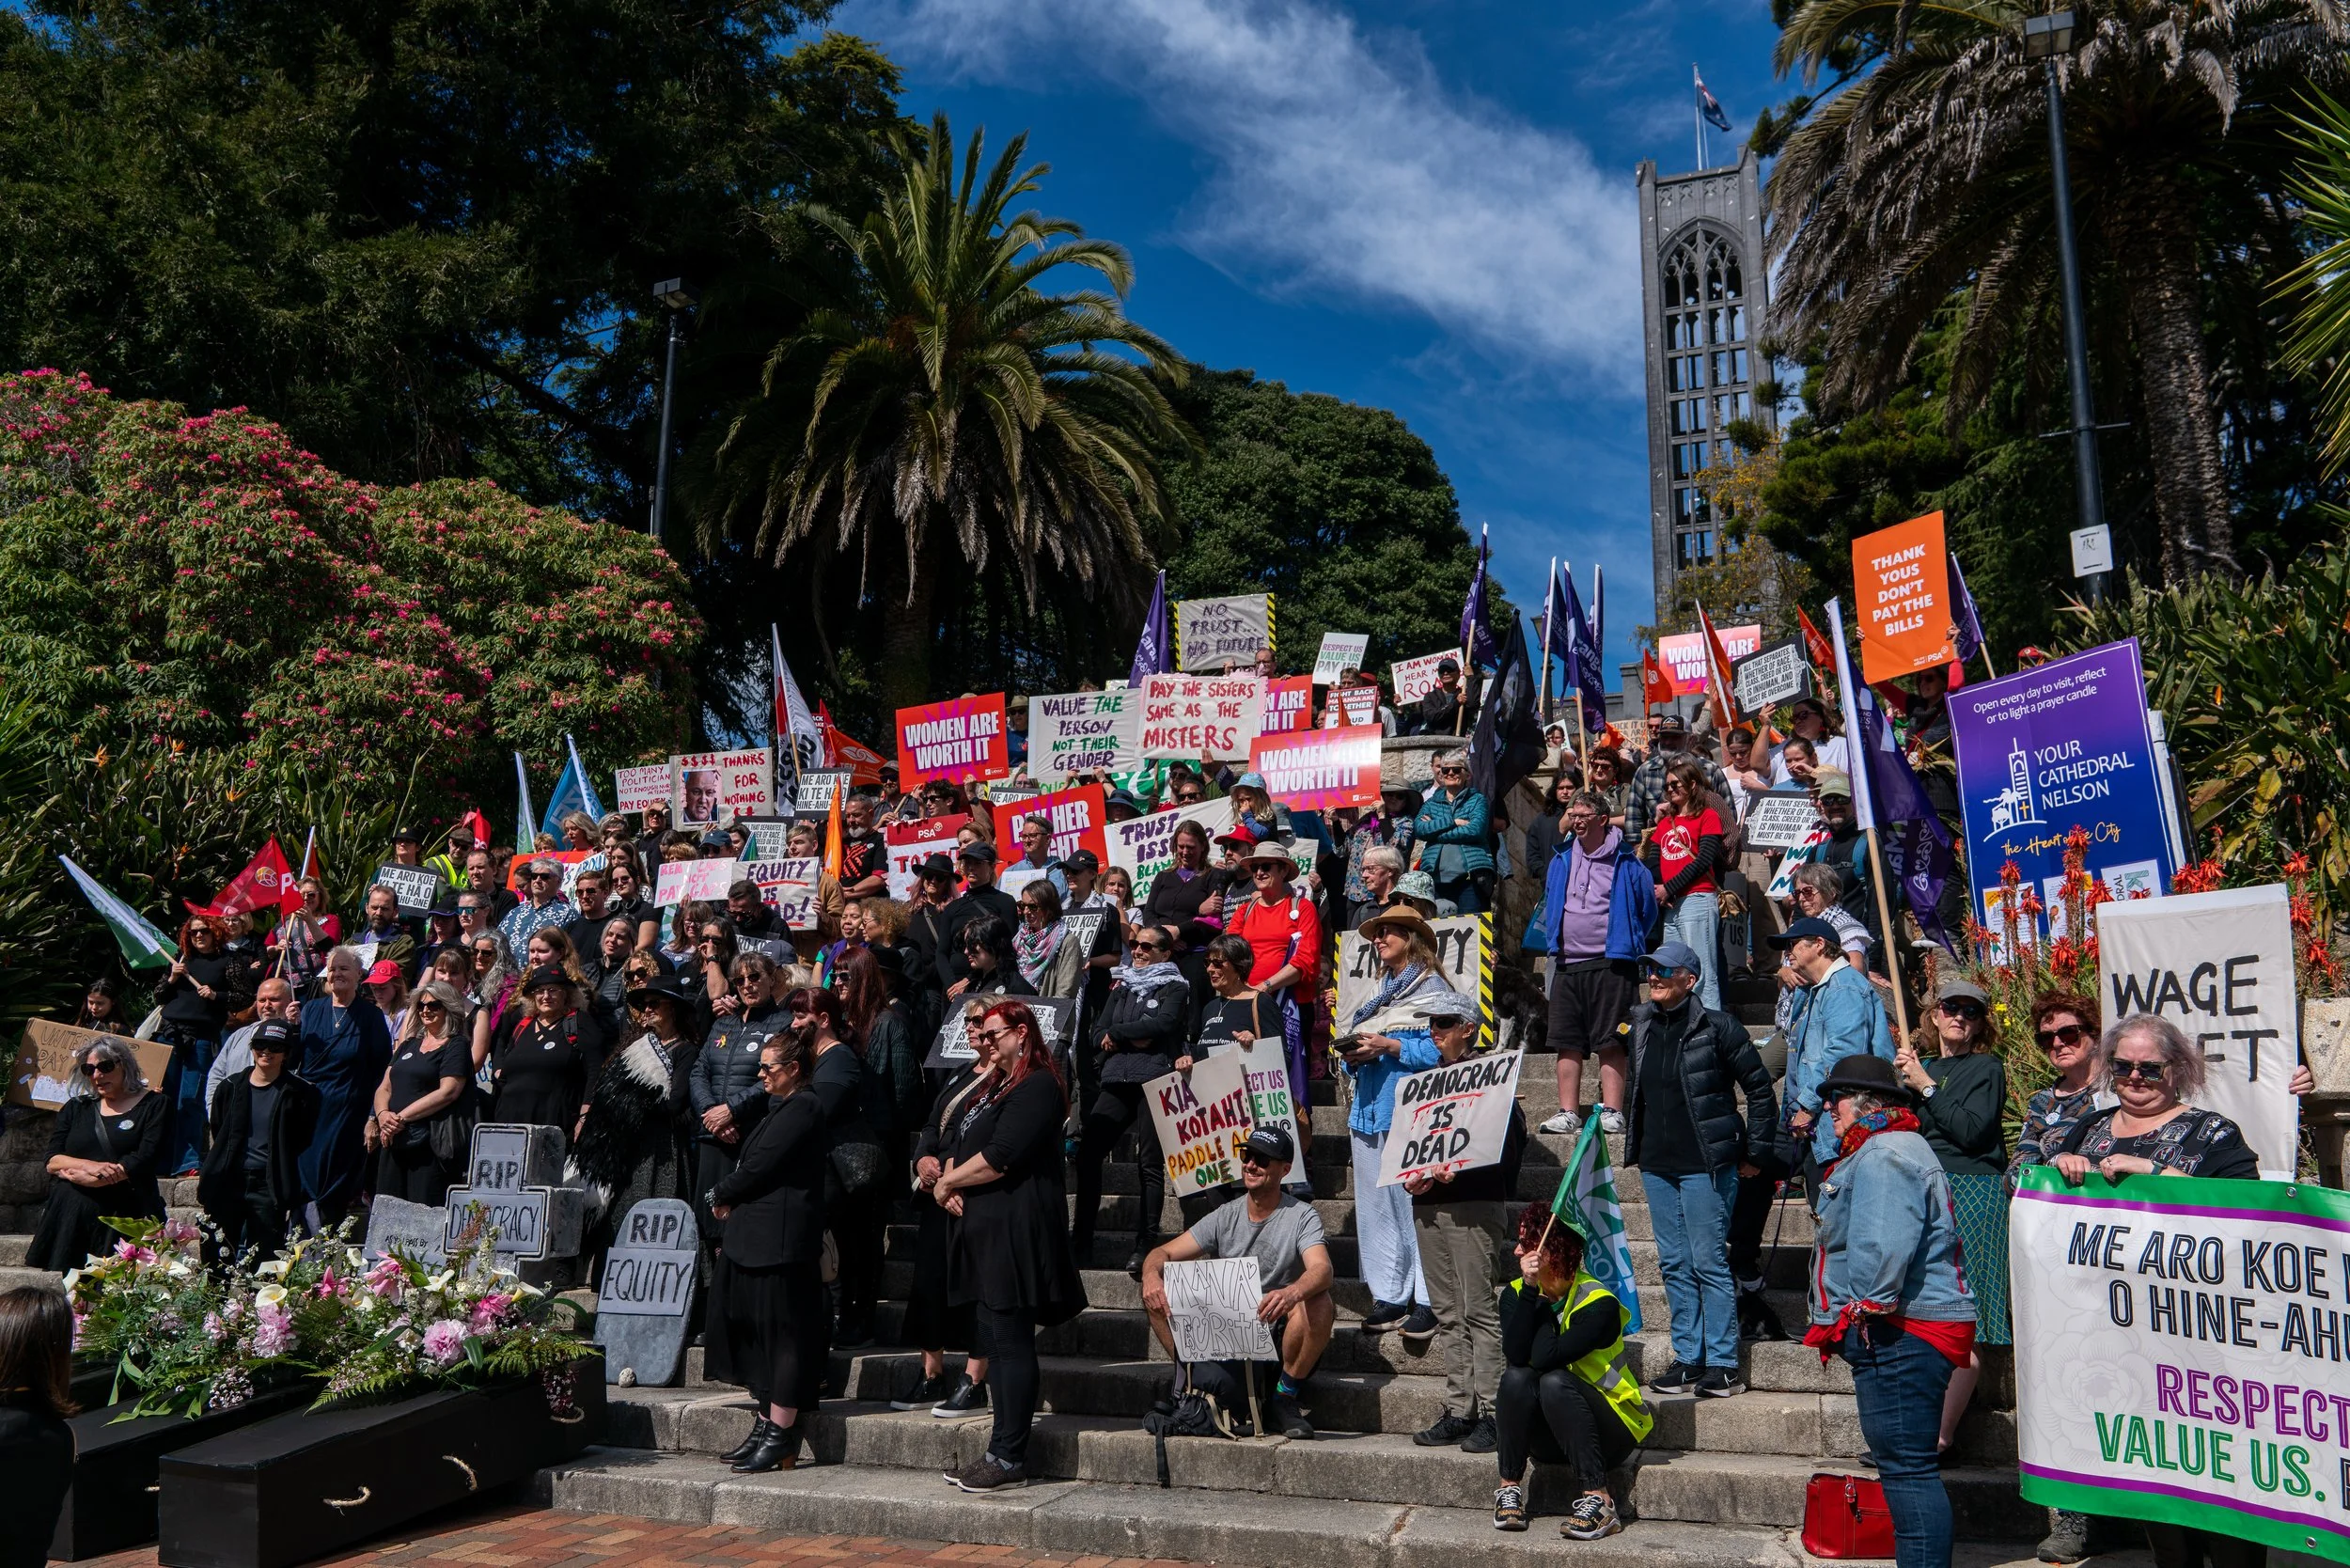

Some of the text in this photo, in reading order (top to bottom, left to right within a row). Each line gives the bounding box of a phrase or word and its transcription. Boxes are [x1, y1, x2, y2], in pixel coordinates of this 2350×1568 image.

[1871, 543, 1926, 571] THANK
[1879, 563, 1920, 586] YOUS
[1202, 604, 1229, 617] NO
[1872, 593, 1934, 623] PAY THE
[1885, 614, 1924, 636] BILLS
[1186, 637, 1264, 658] NO FUTURE
[1320, 651, 1360, 662] VALUE US
[1323, 643, 1363, 653] RESPECT US
[1727, 637, 1754, 657] ARE
[1928, 652, 1943, 662] PSA
[1316, 661, 1342, 673] PAY
[1395, 651, 1458, 674] I AM WOMAN
[1404, 669, 1428, 681] HEAR
[1747, 687, 1752, 697] IS
[1781, 671, 1794, 682] AND
[1150, 681, 1257, 698] PAY THE SISTERS
[1277, 689, 1307, 710] ARE
[1747, 694, 1761, 705] MUST
[1761, 690, 1767, 699] BE
[1767, 681, 1794, 697] OVERCOME
[1973, 666, 2107, 715] Open every day to visit, reflect
[1042, 696, 1123, 716] VALUE THE
[1146, 701, 1242, 722] SAME AS THE
[1986, 683, 2097, 724] or to light a prayer candle
[904, 711, 1000, 747] WOMEN ARE
[1059, 719, 1114, 736] PERSON
[1282, 710, 1296, 730] IT
[1052, 735, 1120, 752] NOT THEIR
[1143, 725, 1237, 751] MISTERS
[723, 753, 766, 768] THANKS
[915, 737, 990, 770] WORTH IT
[1054, 750, 1115, 771] GENDER
[1260, 745, 1336, 771] WOMEN
[2034, 739, 2083, 766] YOUR
[619, 766, 665, 779] TOO MANY
[734, 772, 760, 789] FOR
[801, 774, 831, 785] ME ARO
[1270, 762, 1358, 793] WORTH IT
[2038, 751, 2135, 788] CATHEDRAL
[619, 799, 634, 811] PAY
[724, 791, 766, 806] NOTHING
[798, 788, 823, 800] KI TE
[990, 792, 1019, 803] ME ARO
[2041, 779, 2110, 810] NELSON
[1051, 800, 1090, 835] HER
[1763, 807, 1795, 816] WHETHER
[917, 828, 936, 839] PSA
[1120, 812, 1181, 846] TRUST
[1756, 831, 1774, 839] MUST
[1758, 823, 1767, 831] IS
[2001, 821, 2121, 856] the Heart City
[381, 867, 435, 886] ME ARO KOE
[746, 859, 810, 884] EQUITY
[392, 880, 406, 894] TE
[424, 886, 431, 898] O
[763, 886, 778, 901] IS
[1079, 915, 1101, 928] KOE
[1084, 931, 1094, 945] O
[1730, 924, 1744, 947] US
[2111, 954, 2260, 1019] WAGE
[1268, 1070, 1285, 1090] US
[1402, 1055, 1518, 1105] DEMOCRACY
[1268, 1091, 1289, 1116] US
[1175, 1088, 1251, 1145] KOTAHI
[1429, 1102, 1456, 1130] IS
[1252, 1131, 1278, 1143] mosaic
[1401, 1127, 1471, 1169] DEAD
[1167, 1136, 1226, 1180] PADDLE
[1195, 1158, 1234, 1188] ONE
[451, 1205, 540, 1243] DECRACY
[405, 1238, 418, 1247] PASS
[419, 1239, 428, 1247] BY
[2067, 1221, 2132, 1272] ME
[2137, 1231, 2224, 1285] ARO
[2242, 1239, 2330, 1300] KOE
[601, 1258, 691, 1304] EQUITY
[1168, 1260, 1259, 1310] MANA
[2108, 1278, 2133, 1327] O
[2155, 1363, 2350, 1450] RESPECT
[2093, 1411, 2235, 1483] VALUE
[2249, 1438, 2326, 1503] US.
